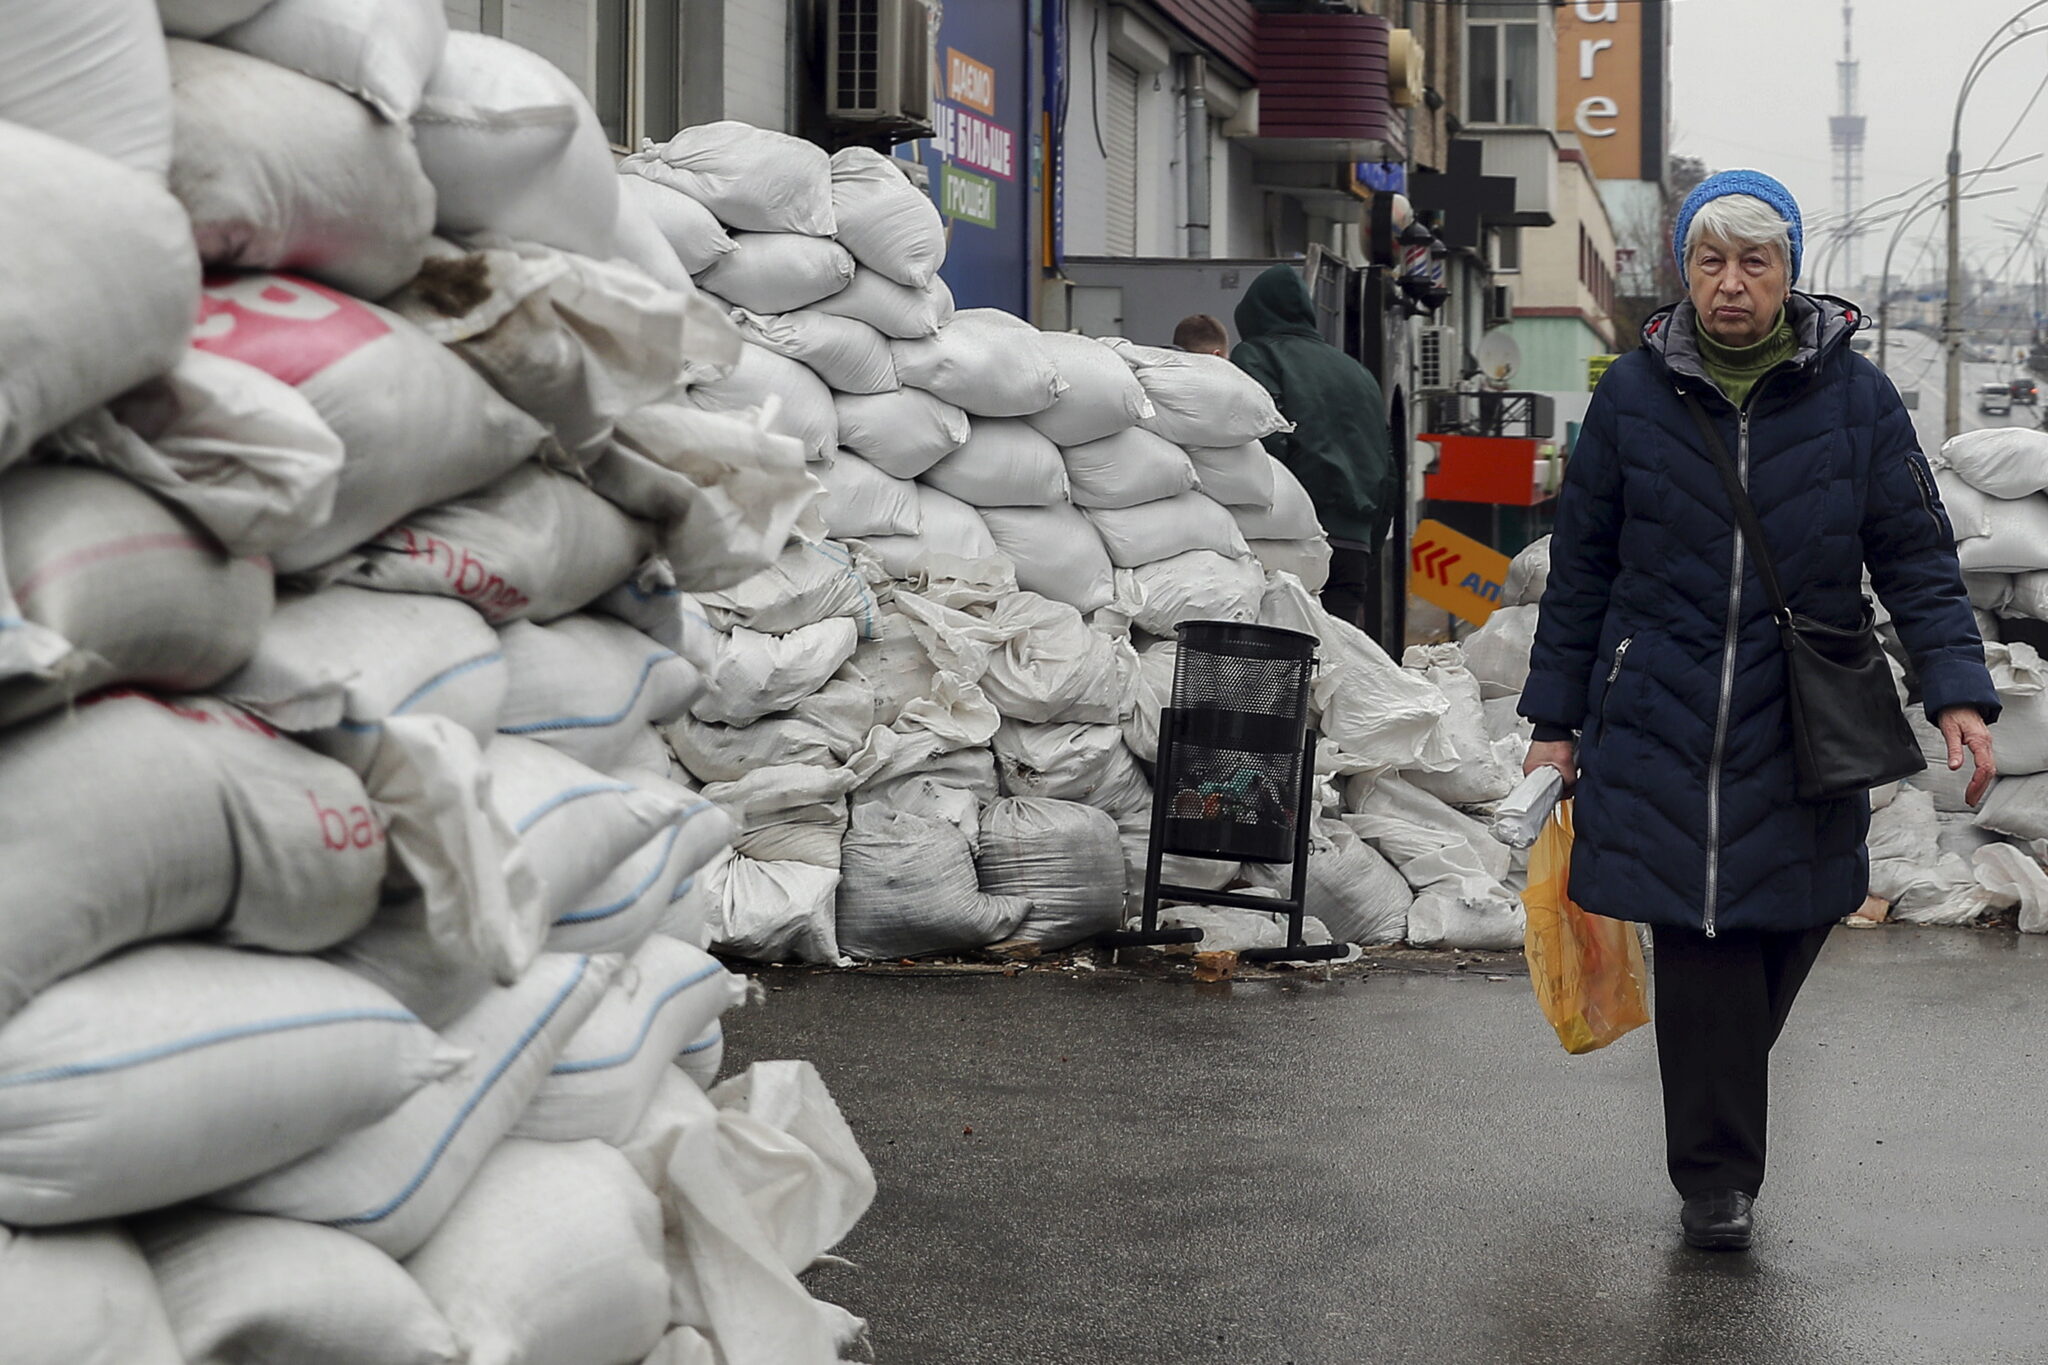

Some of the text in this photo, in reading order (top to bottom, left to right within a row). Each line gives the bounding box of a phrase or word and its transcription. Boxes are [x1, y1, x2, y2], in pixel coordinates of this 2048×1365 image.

[952, 57, 990, 107] ДАЄМО
[957, 112, 1011, 177] БІЛЬШЕ
[946, 173, 991, 221] ГРОШЕЙ
[1459, 571, 1503, 603] АП
[305, 789, 384, 851] ba
